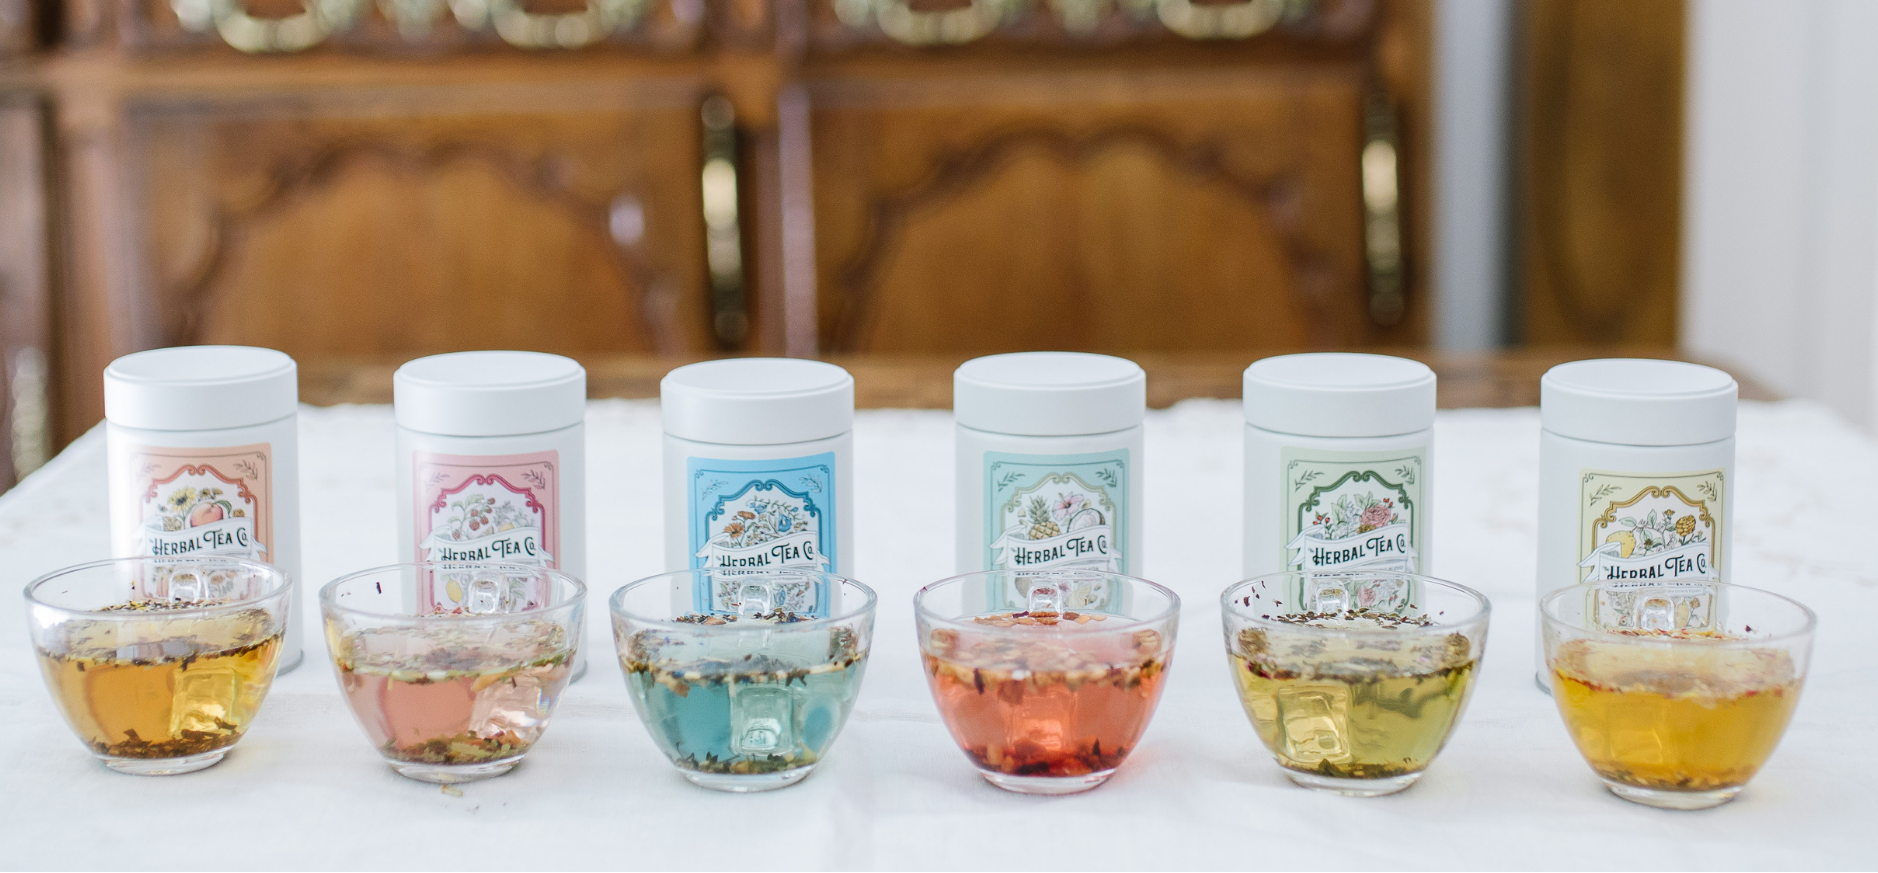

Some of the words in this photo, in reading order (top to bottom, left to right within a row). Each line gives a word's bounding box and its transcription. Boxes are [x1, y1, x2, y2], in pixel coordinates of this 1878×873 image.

[152, 537, 203, 556] HERBAL
[203, 528, 233, 549] TEA
[492, 538, 521, 558] TEA
[772, 542, 800, 564] TEA
[1014, 546, 1066, 566] HERBAL
[1066, 536, 1094, 557] TEA
[1312, 544, 1366, 566] HERBAL
[1366, 535, 1394, 557] TEA
[1664, 554, 1694, 577] TEA
